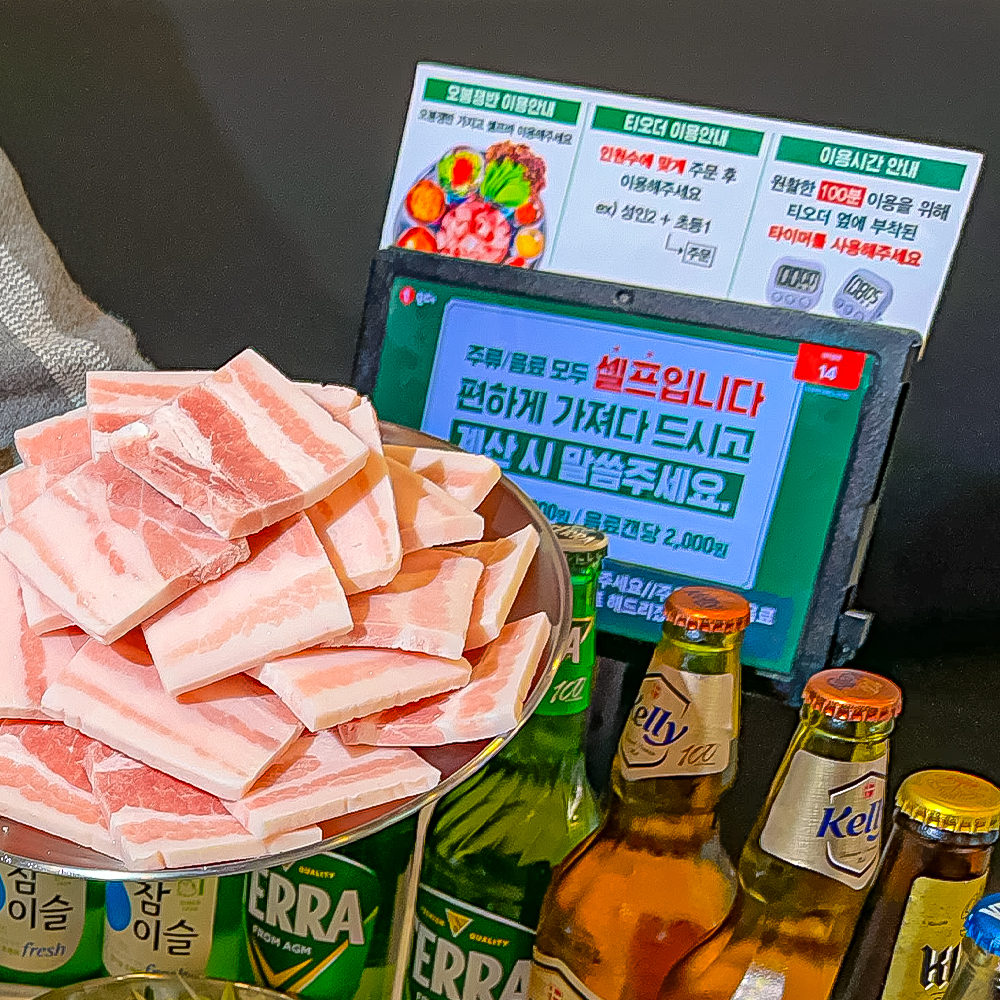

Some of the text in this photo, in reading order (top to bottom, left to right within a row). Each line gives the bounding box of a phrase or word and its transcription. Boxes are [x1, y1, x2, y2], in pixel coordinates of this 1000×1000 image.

[502, 94, 556, 118] 이용안내
[623, 114, 730, 147] 티오더 이용안내
[600, 146, 654, 169] 인원수에
[689, 162, 718, 181] 주문
[820, 147, 920, 179] 이용시간 안내
[621, 175, 701, 201] 이용해주세요
[772, 175, 951, 221] 원활한 100분 이용을 위해
[596, 202, 617, 217] ex)
[621, 205, 656, 224] 성인2
[673, 215, 711, 234] 초등1
[787, 204, 918, 241] 티오더 옆에 부착된
[769, 226, 922, 267] 타이머를 사용해주세요
[465, 344, 547, 377] 주류/음료
[550, 359, 590, 384] 모두
[595, 354, 766, 418] 셀프입니다
[819, 364, 838, 382] 14
[457, 377, 756, 464] 편하게 가져다 드시고
[519, 438, 554, 477] 시
[663, 527, 729, 559] 2,000원
[631, 703, 690, 747] elly
[298, 865, 336, 880] QUALITY
[8, 895, 75, 931] 이슬
[248, 868, 365, 945] ERRA
[21, 941, 67, 958] fresh
[133, 919, 199, 956] 이슬
[252, 924, 313, 956] FROM AGM
[468, 931, 511, 948] QUALITY
